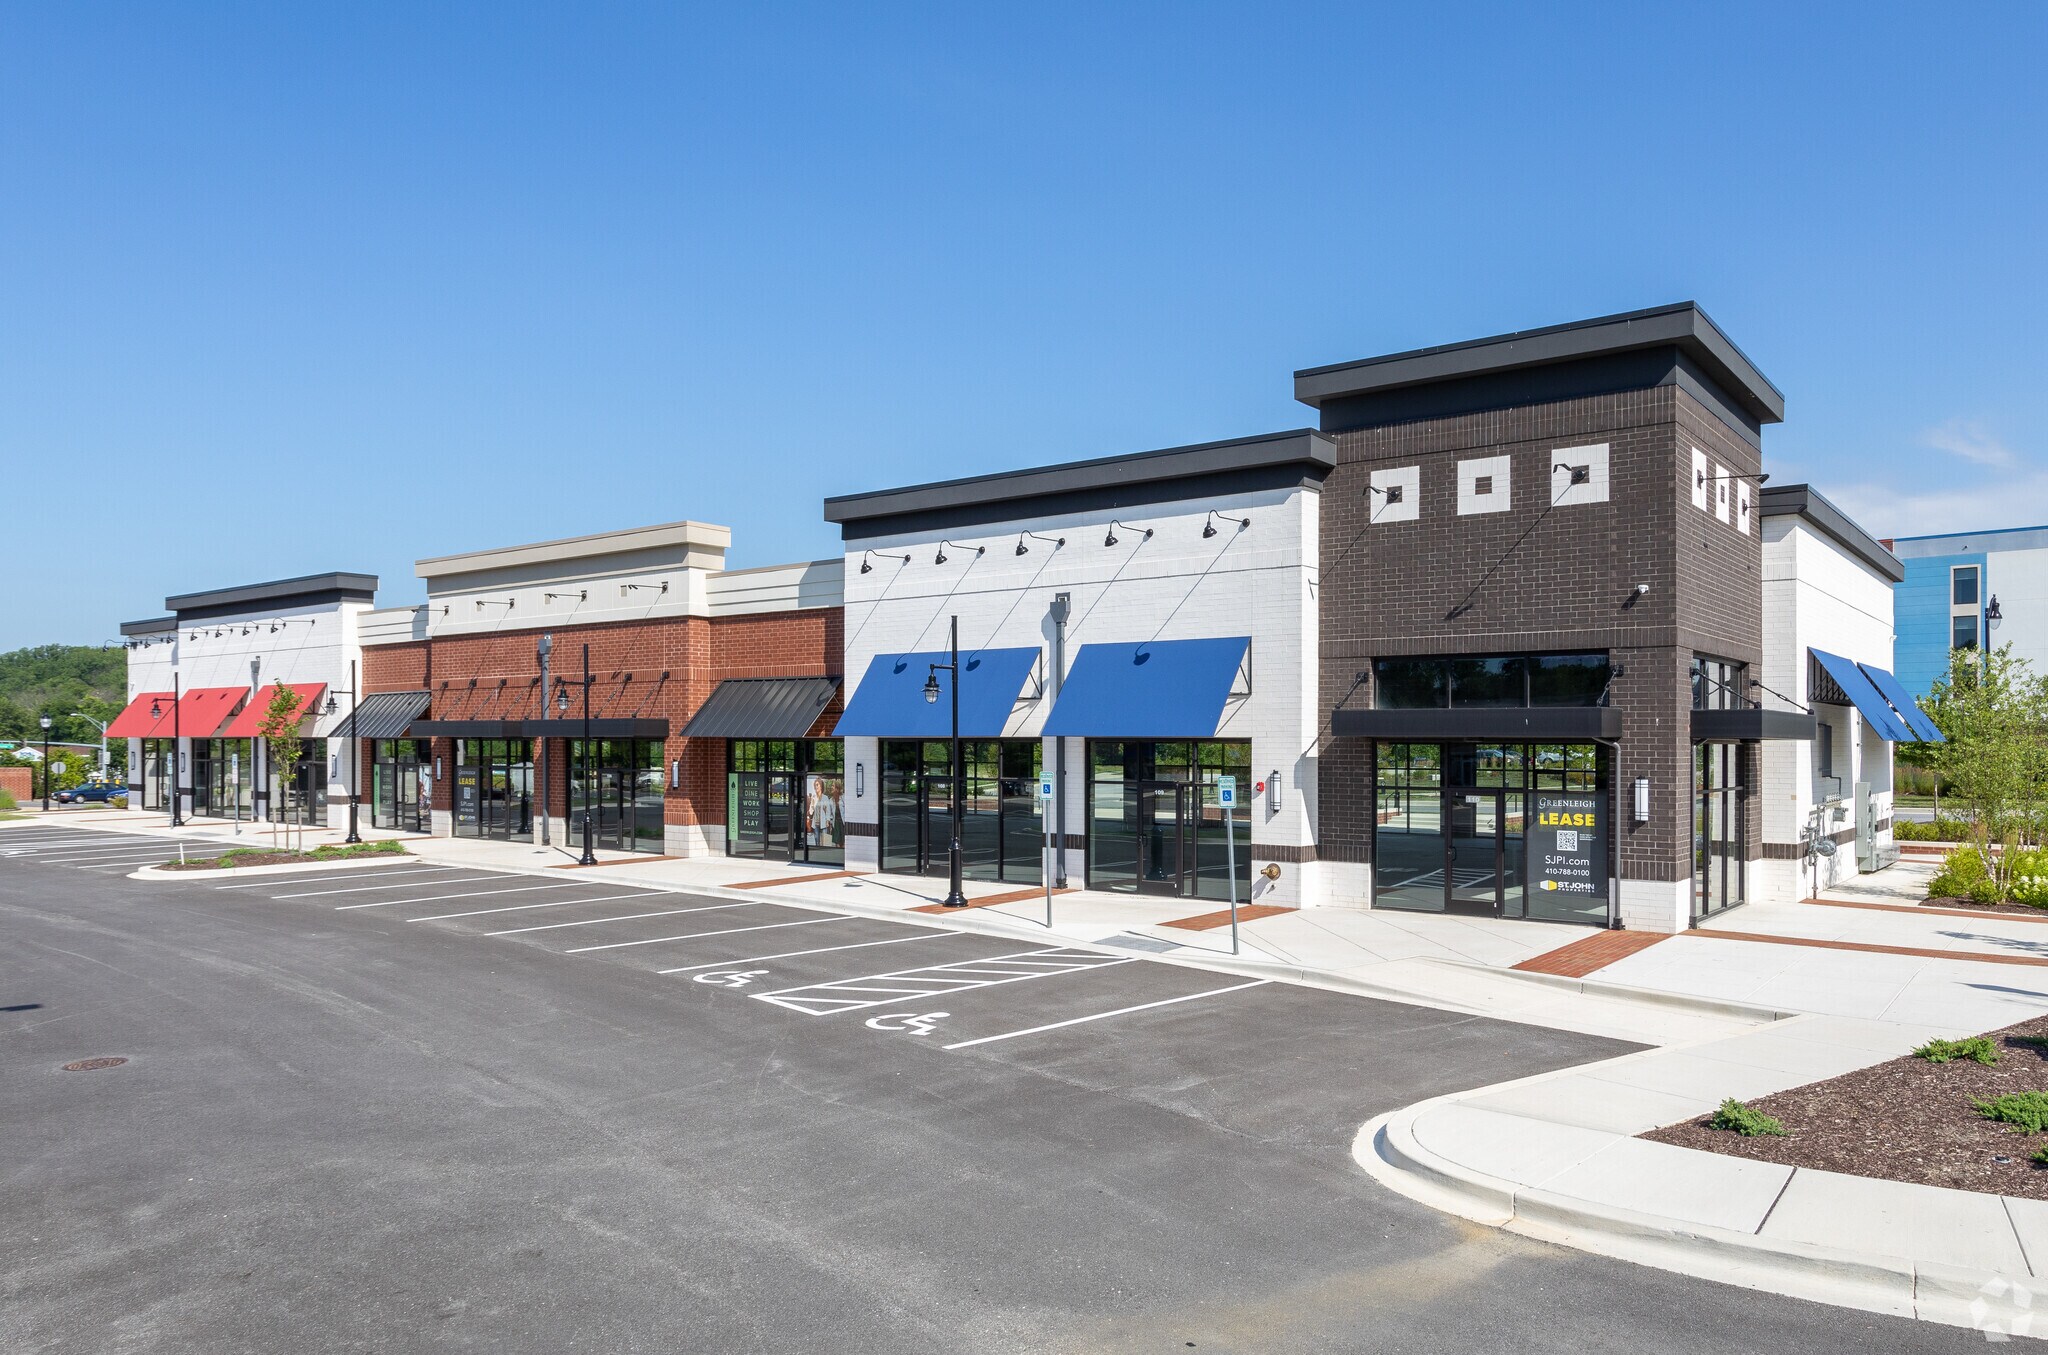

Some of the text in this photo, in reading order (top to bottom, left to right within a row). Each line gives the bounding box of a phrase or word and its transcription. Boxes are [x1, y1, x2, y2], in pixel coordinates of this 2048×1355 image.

[1539, 812, 1595, 826] LEASE
[1545, 855, 1590, 866] SJPI.com
[1545, 868, 1590, 876] 410-788-0100
